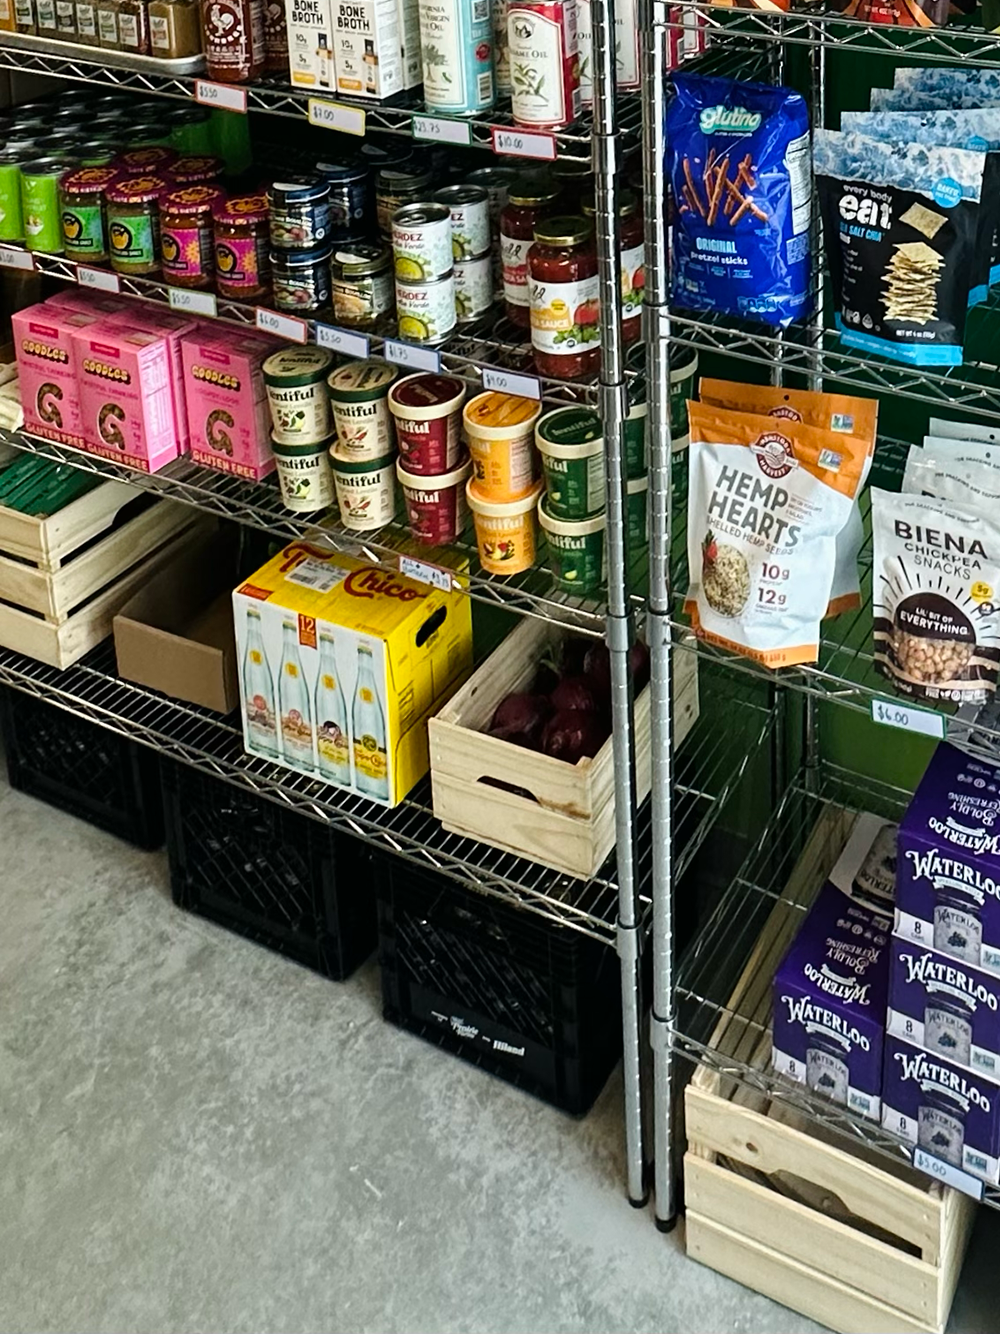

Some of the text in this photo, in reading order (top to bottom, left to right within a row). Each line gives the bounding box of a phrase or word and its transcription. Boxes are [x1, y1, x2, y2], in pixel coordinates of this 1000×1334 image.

[291, 11, 324, 25] BROTH
[293, 0, 320, 13] BONE
[701, 105, 761, 130] glutino
[839, 195, 893, 230] eat
[690, 251, 748, 265] pretzel sticks
[696, 237, 737, 254] ORIGINAL
[192, 450, 257, 480] GLUTEN FREE
[715, 465, 789, 509] HEMP
[707, 491, 802, 547] HEARTS
[894, 519, 988, 560] BIENA
[904, 542, 982, 571] CHICKPEA
[913, 555, 971, 581] SNACKS
[344, 566, 427, 603] Chico
[900, 611, 969, 636] EVERYTHING
[877, 705, 910, 726] $6.00
[780, 994, 870, 1051] WATERLOO
